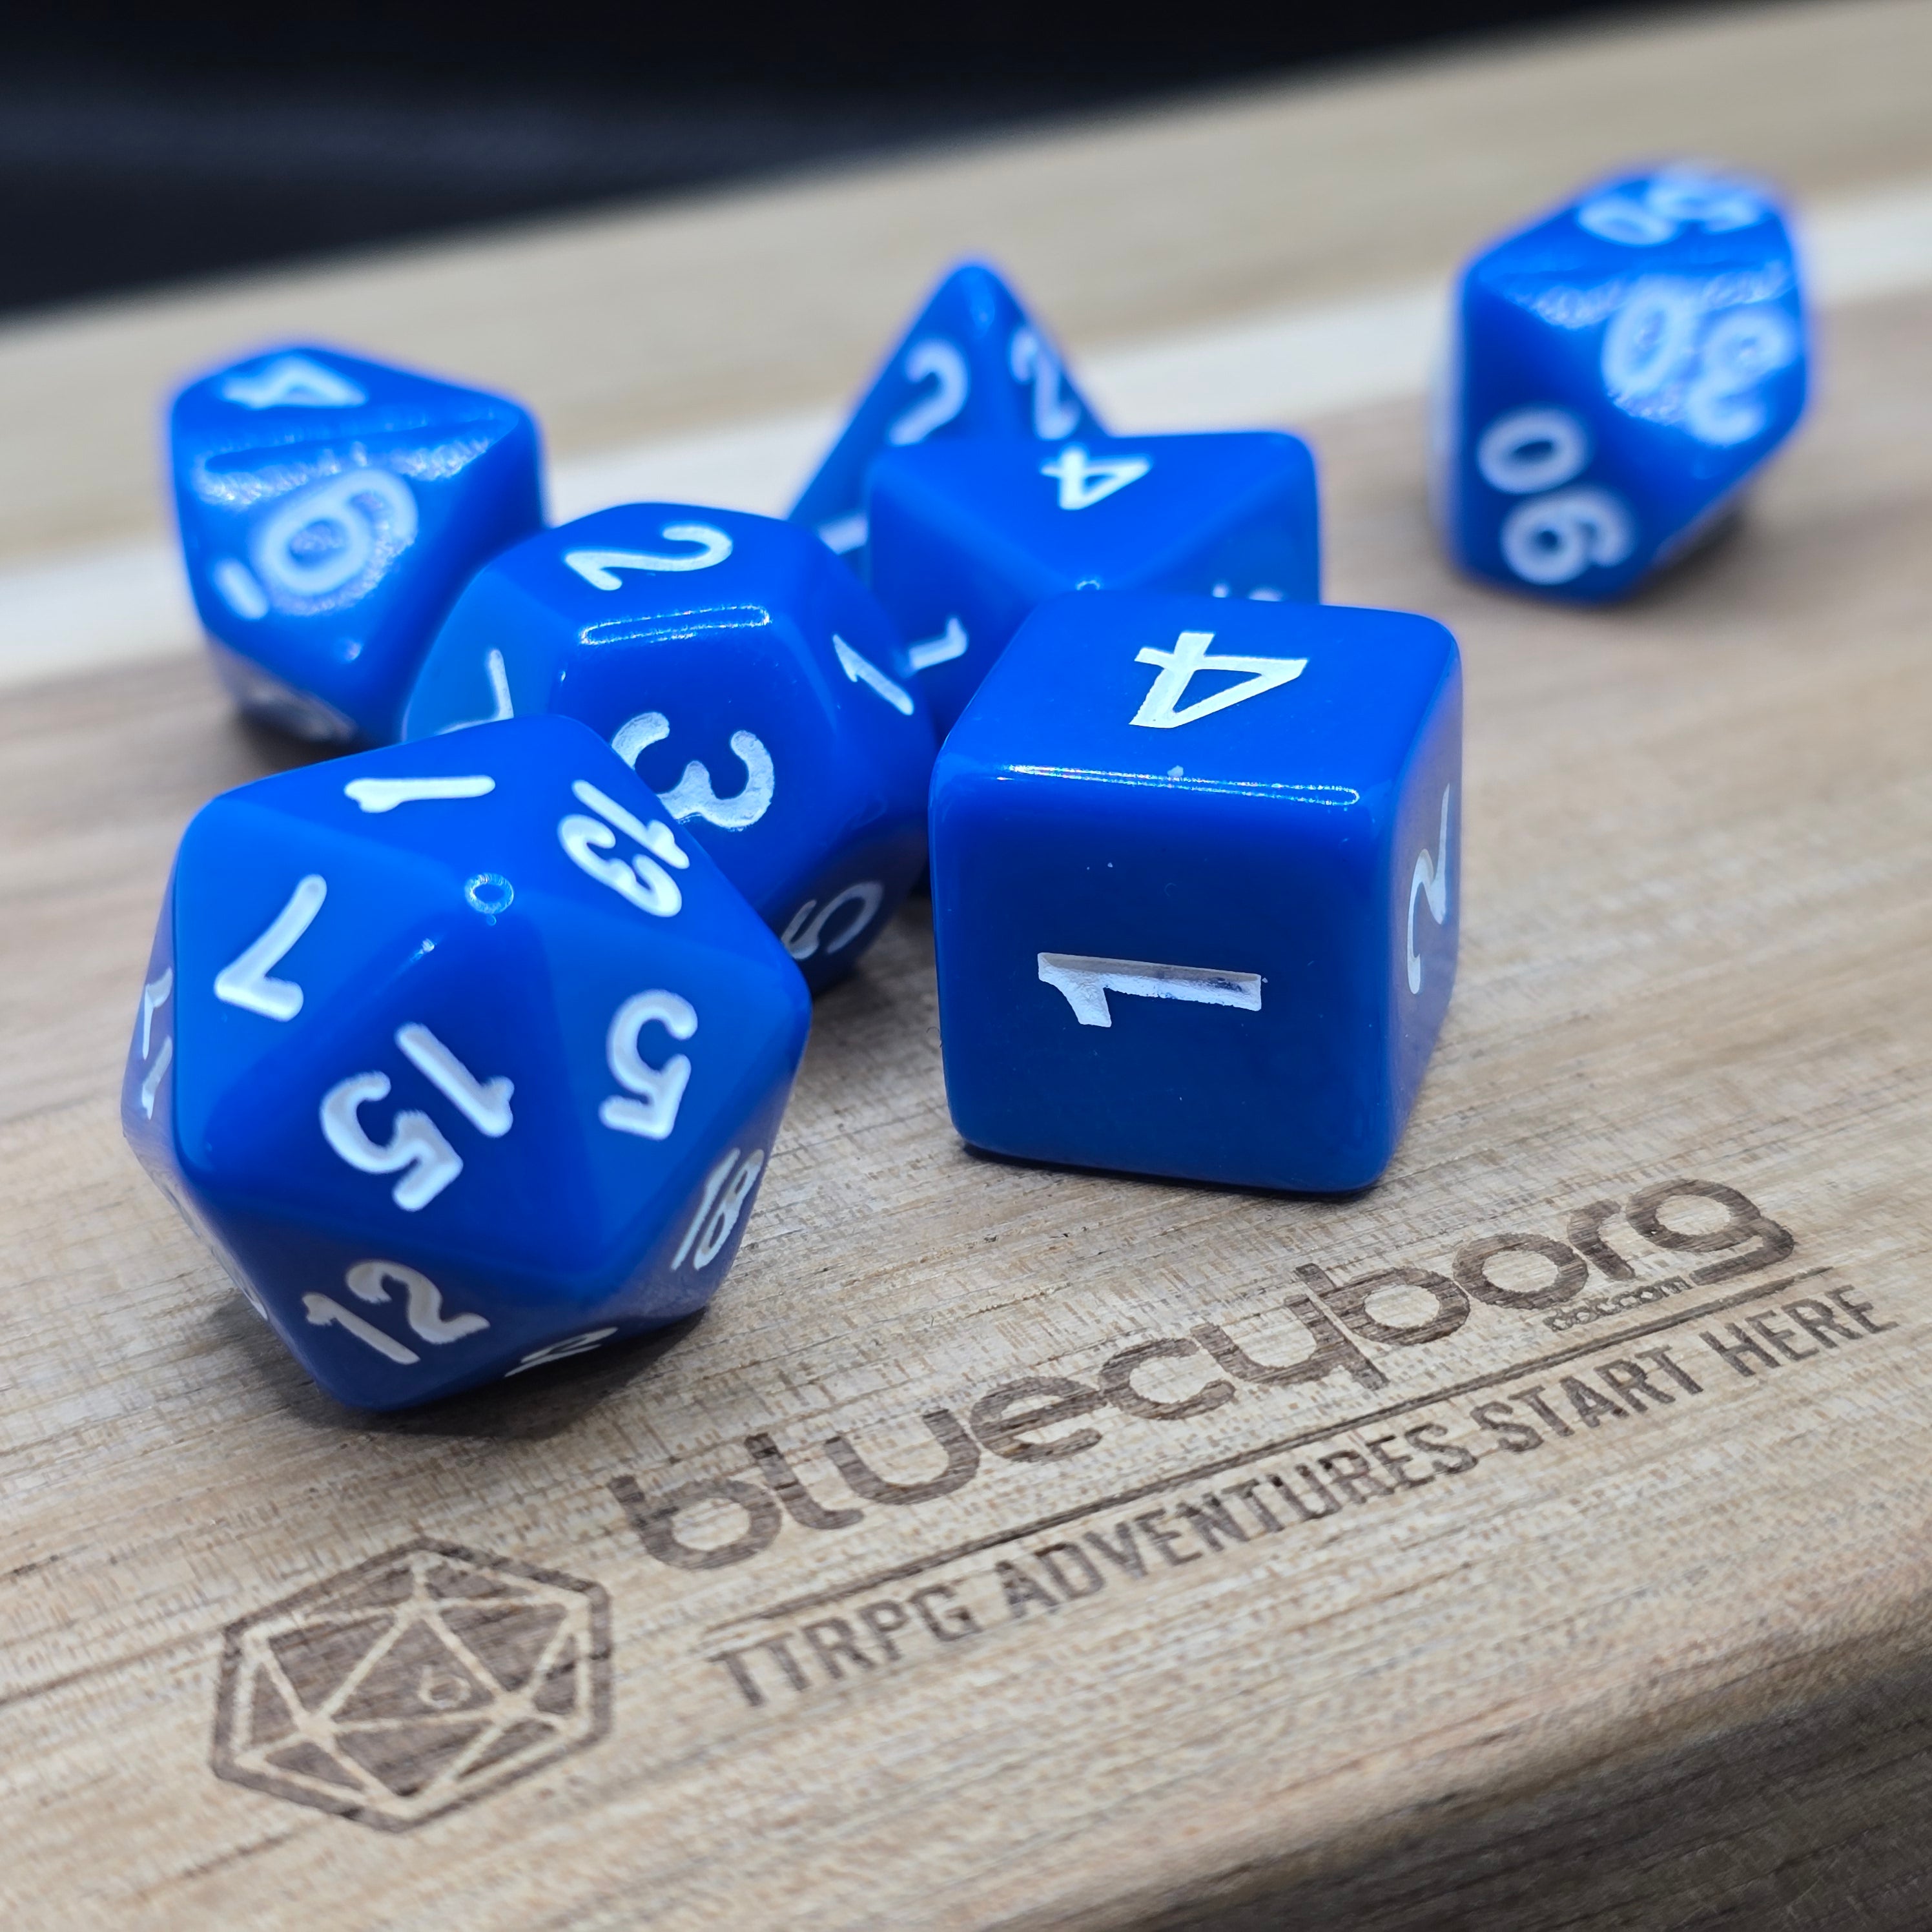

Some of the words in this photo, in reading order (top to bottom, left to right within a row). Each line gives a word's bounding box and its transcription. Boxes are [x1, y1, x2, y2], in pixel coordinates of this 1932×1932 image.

[1040, 444, 1152, 510] 4
[563, 524, 734, 590] 2
[831, 633, 916, 715] 1
[1129, 632, 1308, 728] 4
[346, 774, 497, 814] 1
[611, 712, 775, 832] 3
[559, 779, 692, 918] 13
[1406, 783, 1450, 996] 2
[214, 873, 327, 1018] 7
[1037, 951, 1262, 1028] 1
[320, 1022, 515, 1212] 15
[598, 989, 699, 1141] 5
[670, 1147, 765, 1271] 18
[300, 1259, 491, 1365] 12
[606, 1178, 1795, 1570] bluecyborg
[708, 1584, 983, 1709] TTRPG
[993, 1421, 1479, 1619] ADVENTURES
[1472, 1344, 1705, 1455] START
[1700, 1284, 1901, 1377] HERE
